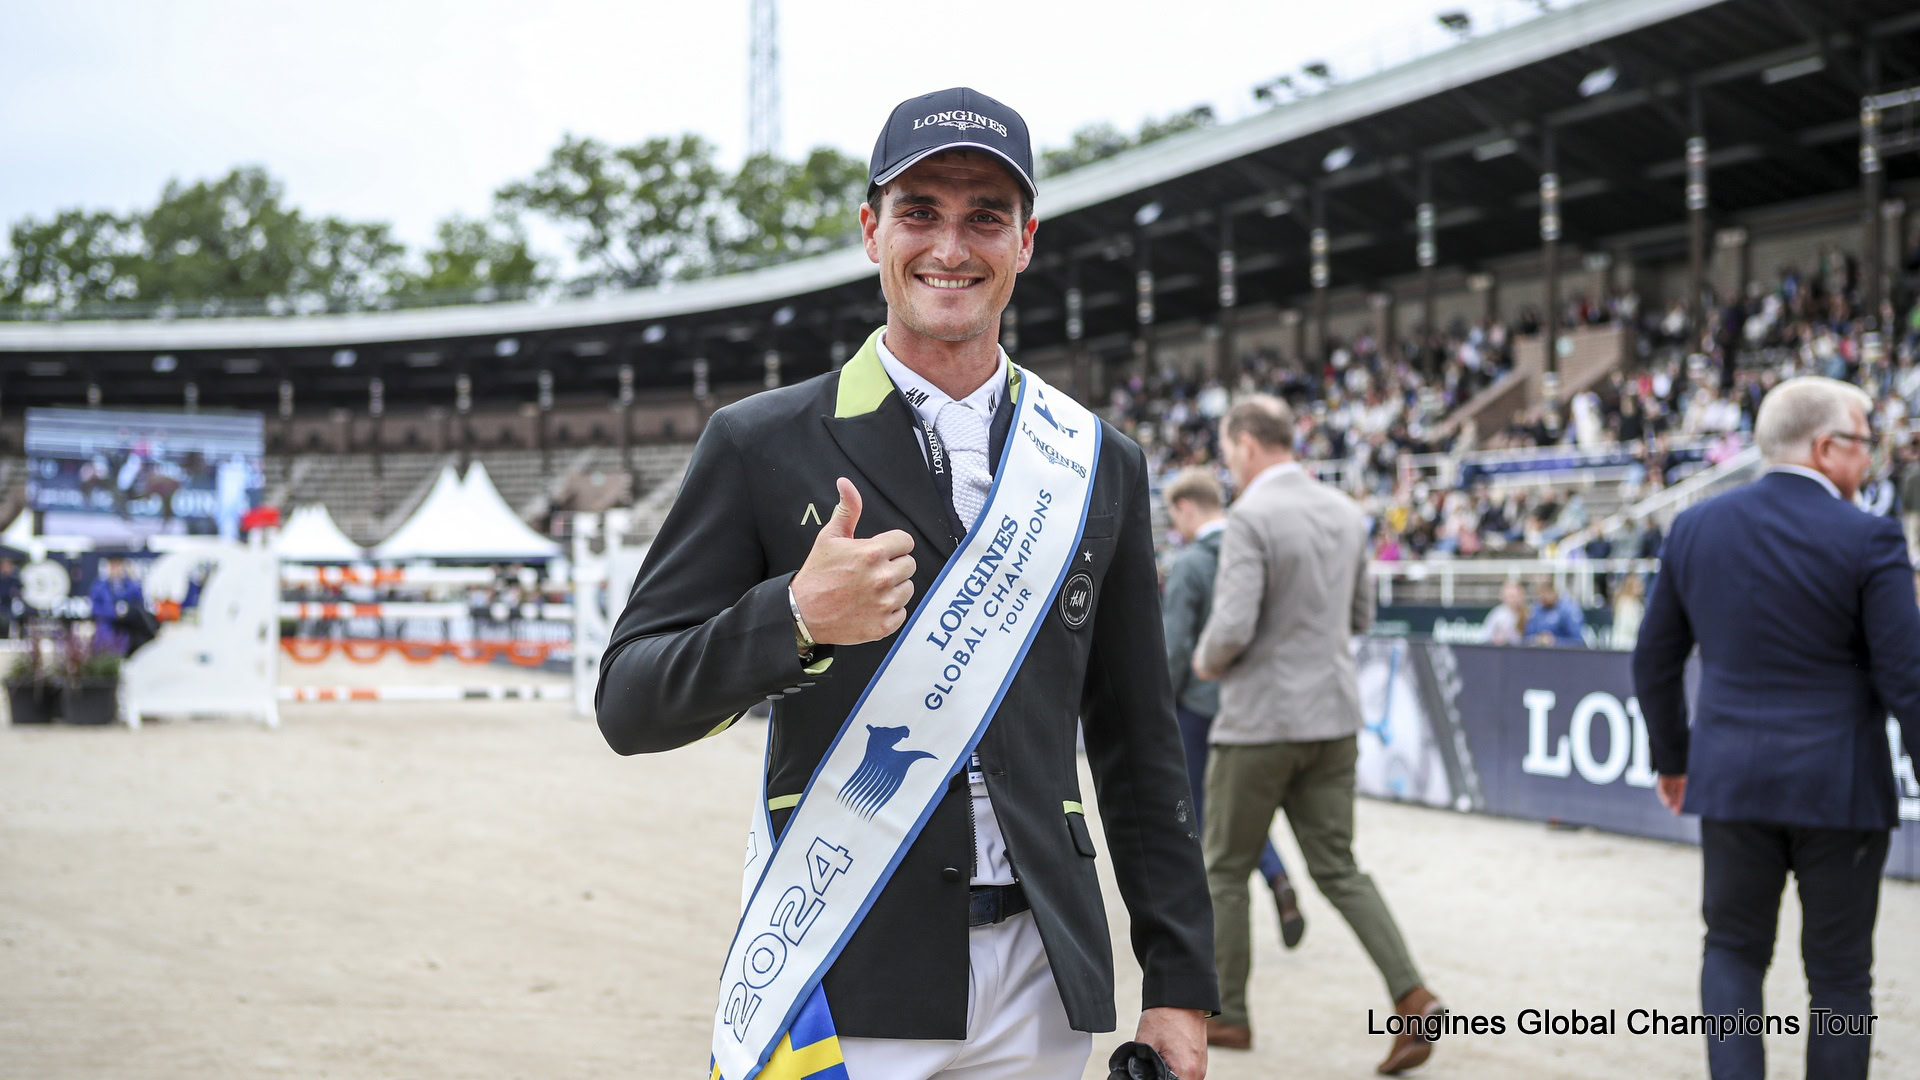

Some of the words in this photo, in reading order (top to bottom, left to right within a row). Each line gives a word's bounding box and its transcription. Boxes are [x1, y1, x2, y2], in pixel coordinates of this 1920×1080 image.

[912, 110, 1008, 138] LONGINES
[922, 419, 944, 475] LONGINES
[1021, 420, 1088, 479] LONGINES
[924, 626, 988, 711] GLOBAL
[983, 488, 1053, 619] CHAMPIONS
[926, 514, 1019, 652] LONGINES
[999, 588, 1032, 634] TOUR
[1069, 590, 1087, 608] H&M
[724, 836, 854, 1044] 2024
